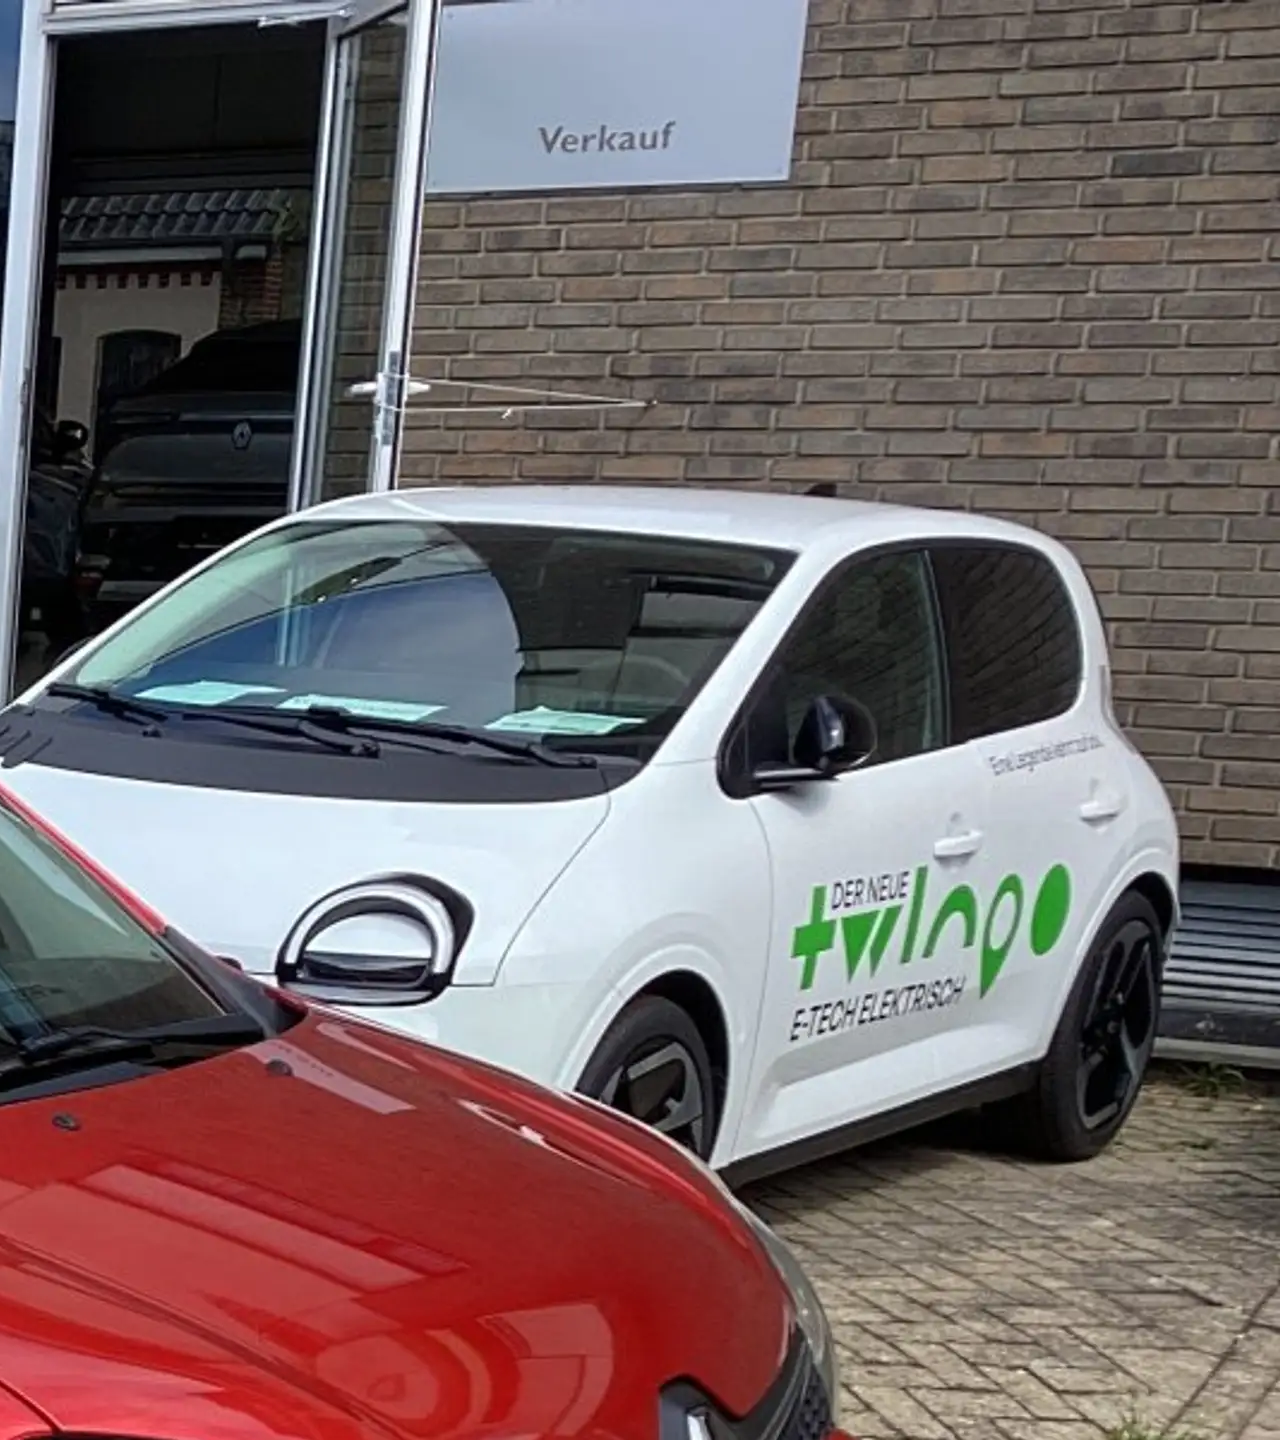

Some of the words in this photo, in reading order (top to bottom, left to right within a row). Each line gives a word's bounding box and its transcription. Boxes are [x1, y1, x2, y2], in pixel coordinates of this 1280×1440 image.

[538, 121, 676, 154] Verkauf
[831, 878, 865, 910] DER
[867, 871, 910, 901] NEUE
[790, 997, 856, 1042] E-TECH
[857, 976, 966, 1025] ELEKTRISCH
